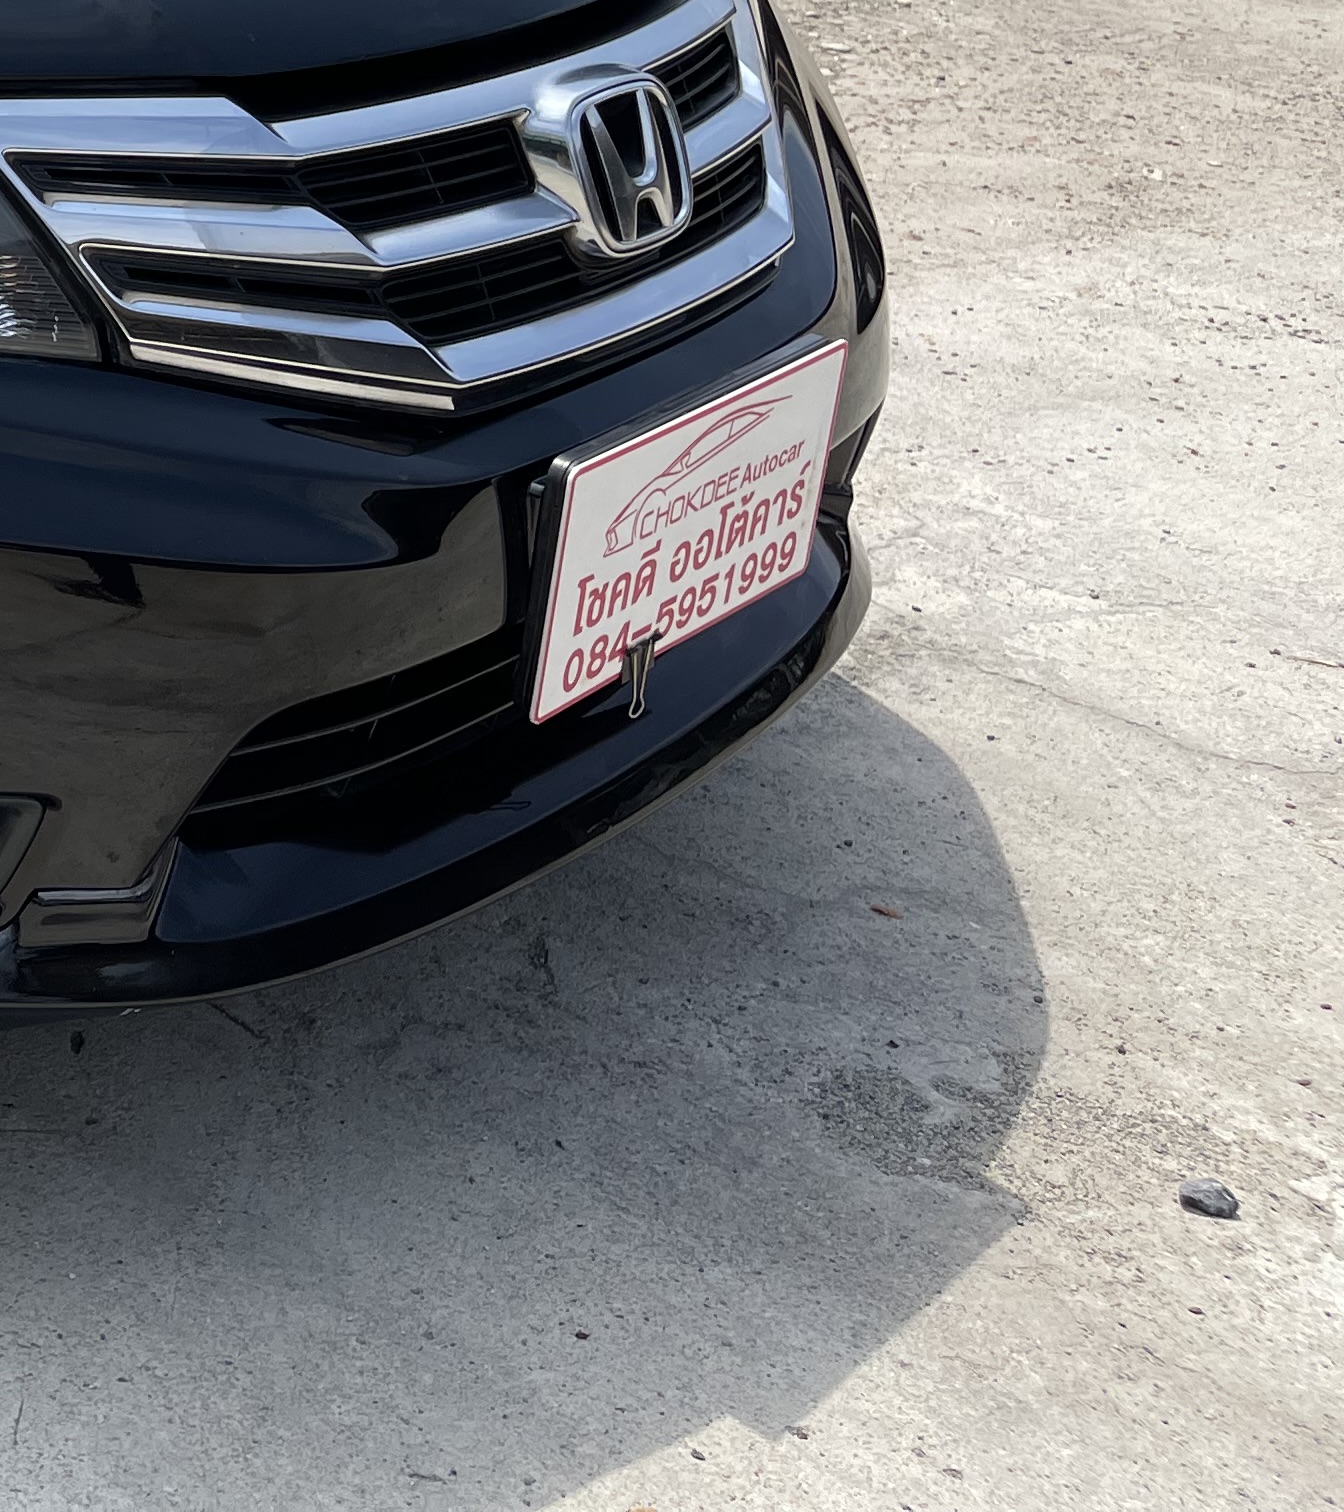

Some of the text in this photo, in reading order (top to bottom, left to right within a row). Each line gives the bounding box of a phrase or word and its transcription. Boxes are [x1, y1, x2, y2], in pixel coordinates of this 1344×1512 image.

[573, 459, 811, 637] โชคดี ออโต้คาร์
[639, 440, 805, 539] CHOKDEE Autocar
[562, 531, 797, 693] 084-5951999
